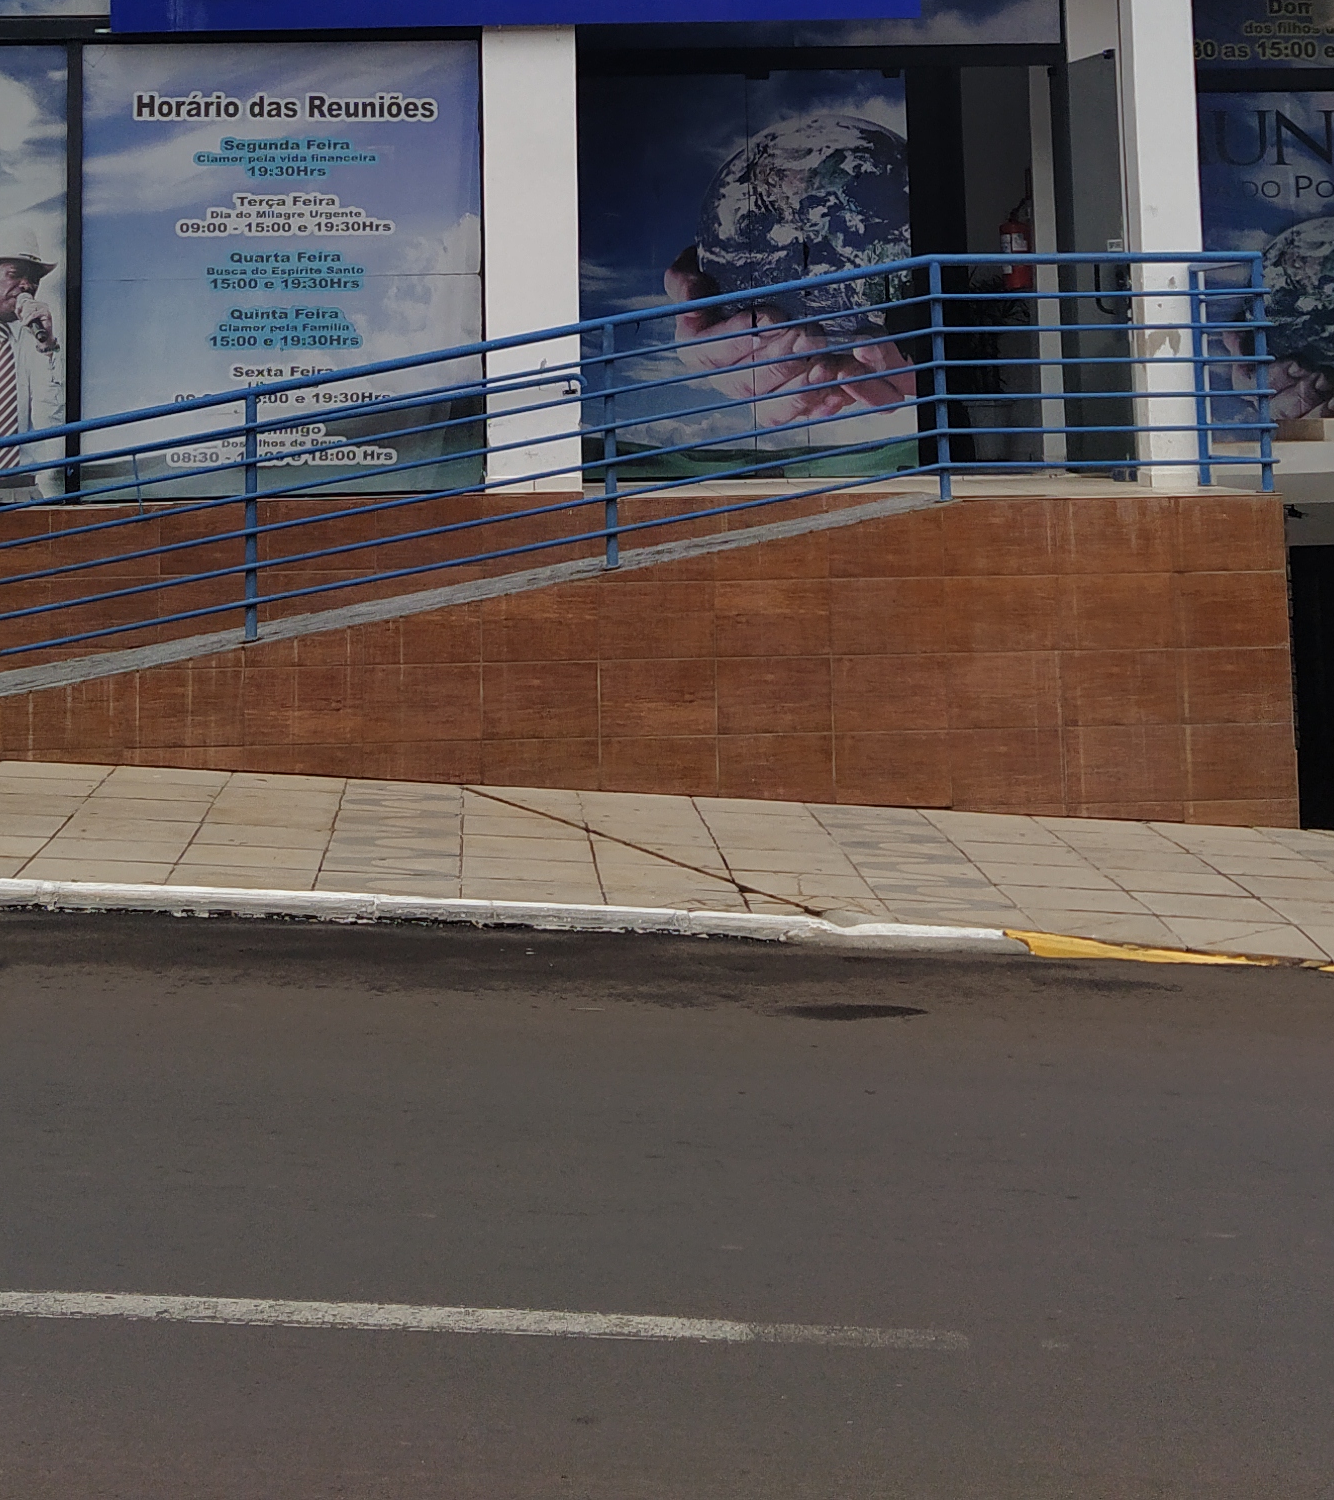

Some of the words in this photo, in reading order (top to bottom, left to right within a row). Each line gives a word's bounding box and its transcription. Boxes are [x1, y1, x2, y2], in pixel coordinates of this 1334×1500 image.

[1257, 41, 1317, 58] 15:00
[135, 94, 241, 118] Horário
[249, 96, 299, 119] das
[307, 95, 436, 118] Reuniões
[223, 139, 301, 153] Segunda
[306, 139, 351, 151] Feira
[196, 154, 245, 163] Clamor
[247, 154, 276, 165] pela
[279, 154, 308, 163] vida
[310, 153, 377, 163] financeira
[247, 165, 327, 177] 19:30Hrs
[236, 197, 286, 208] Terça
[292, 196, 336, 207] Feira
[210, 211, 232, 220] Dia
[235, 211, 252, 220] do
[255, 210, 306, 221] Milagre
[309, 210, 362, 221] Urgente
[179, 222, 228, 234] 09:00
[244, 222, 292, 233] 15:00
[297, 224, 308, 233] e
[314, 221, 392, 233] 19:30Hrs
[229, 252, 291, 263] Quarta
[297, 252, 341, 263] Feira
[206, 267, 248, 276] Busca
[251, 266, 267, 276] do
[326, 266, 365, 275] Santo
[210, 278, 258, 290] 15:00
[263, 280, 275, 290] e
[280, 278, 360, 289] 19:30Hrs
[230, 308, 288, 320] Quinta
[294, 308, 339, 319] Feira
[218, 323, 267, 332] Clamor
[269, 323, 298, 334] pela
[209, 335, 258, 347] 15:00
[263, 337, 274, 346] e
[279, 335, 360, 347] 19:30Hrs
[232, 366, 283, 377] Sexta
[295, 394, 306, 404] e
[290, 438, 307, 447] de
[170, 451, 220, 464] 08:30
[310, 450, 357, 462] 18:00
[362, 449, 394, 461] Hrs
